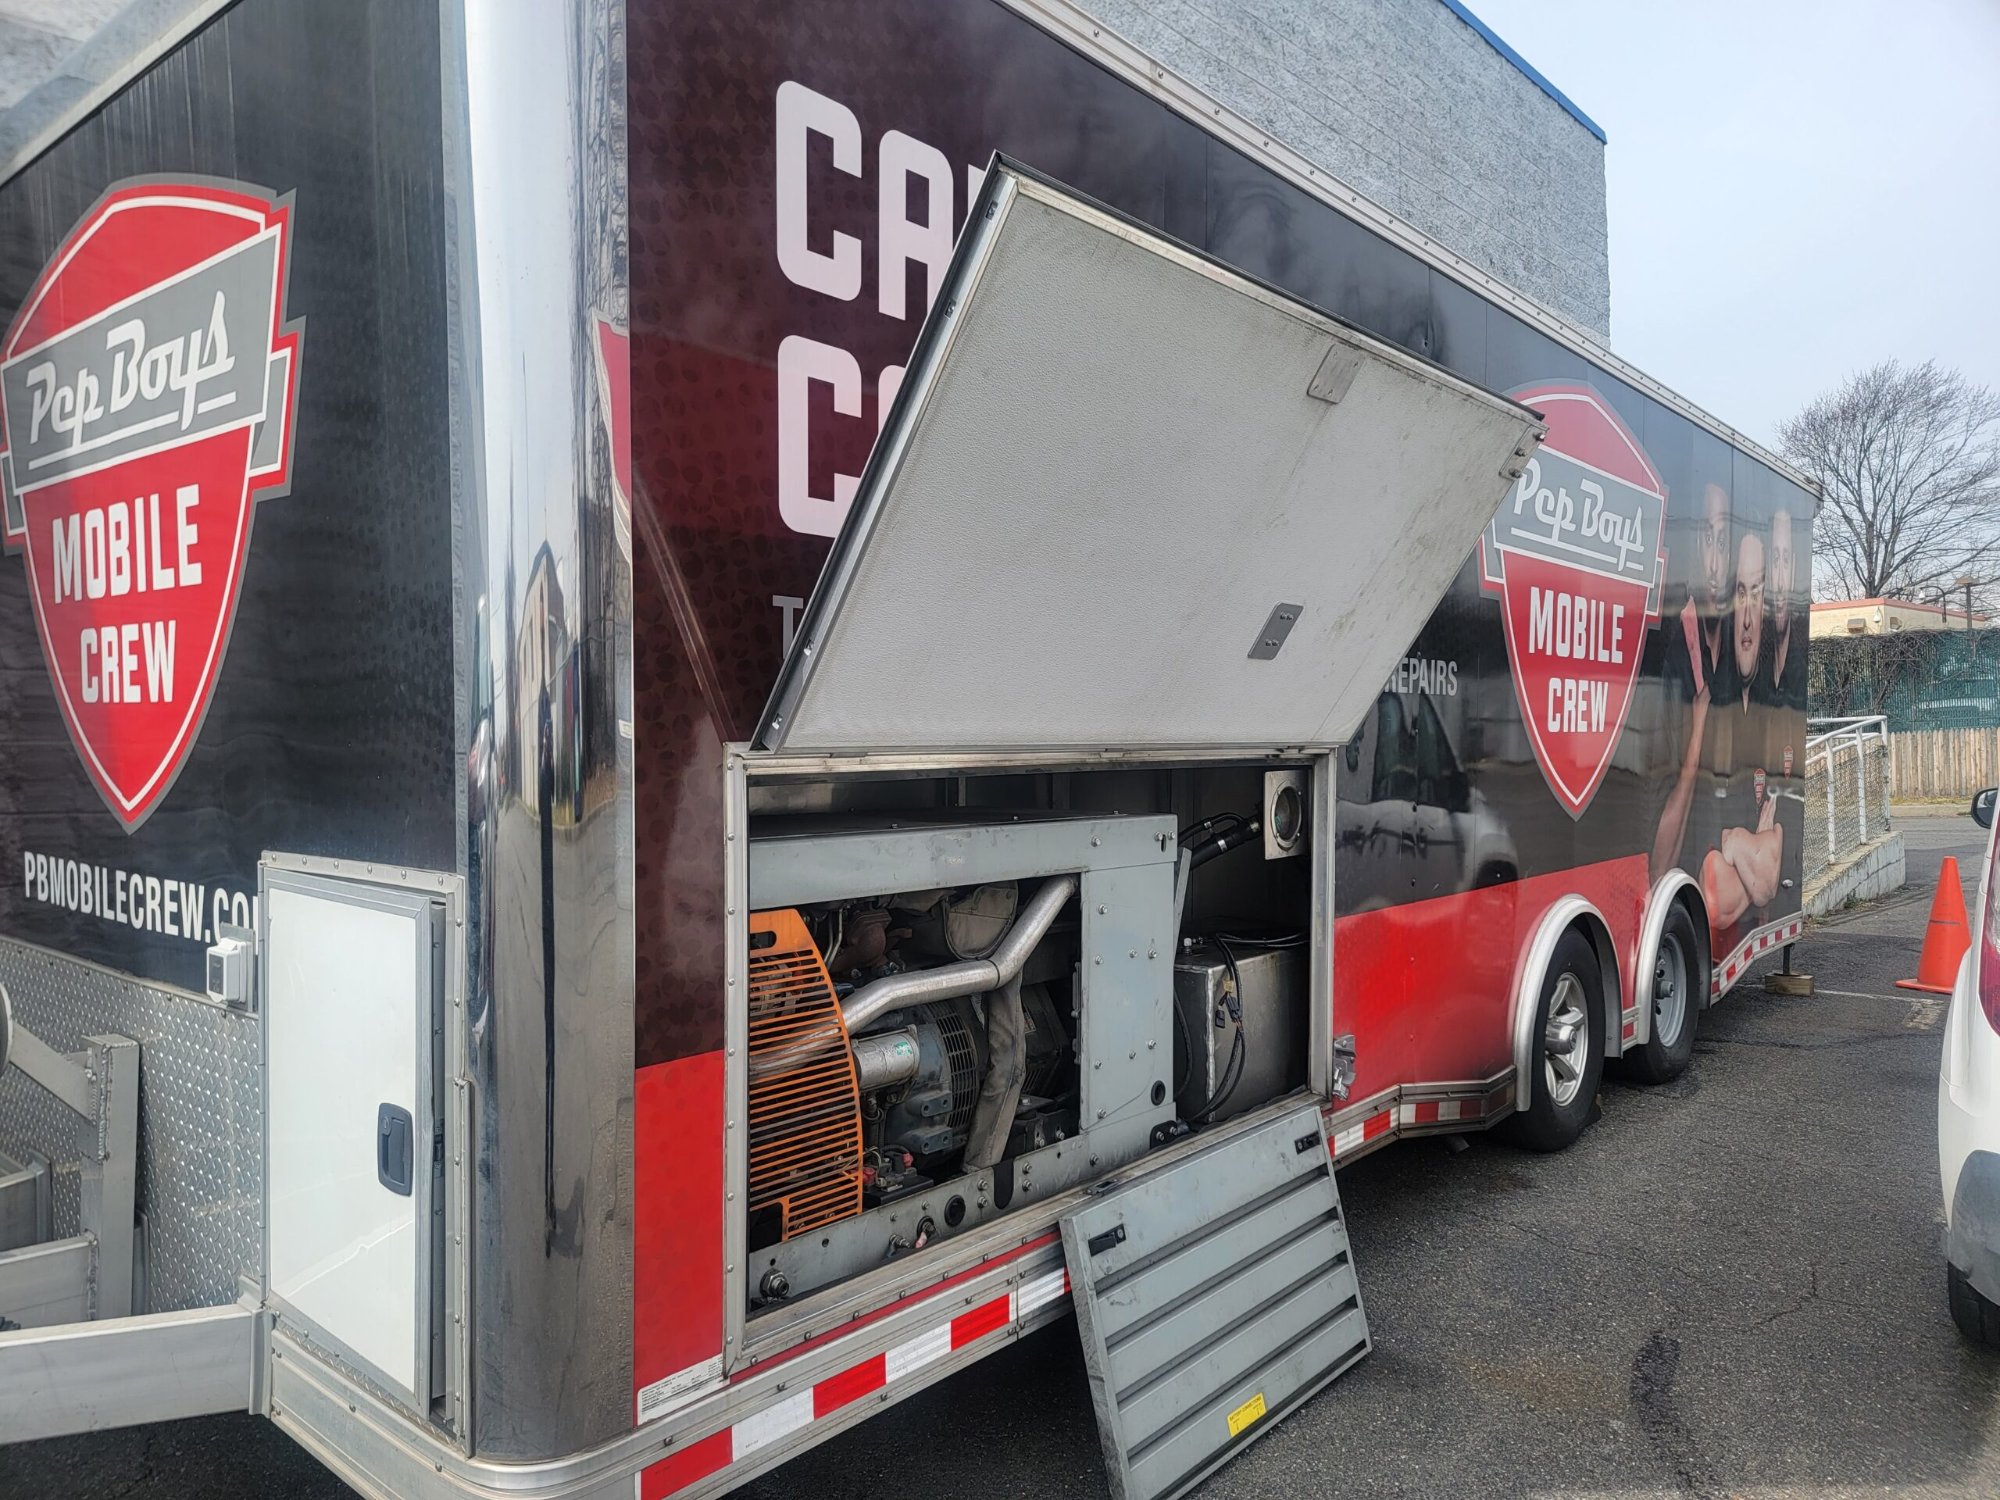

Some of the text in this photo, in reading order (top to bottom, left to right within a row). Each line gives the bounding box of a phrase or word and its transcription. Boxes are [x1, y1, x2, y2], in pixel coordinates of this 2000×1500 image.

[776, 80, 986, 321] CA
[27, 290, 236, 448] Pep Boys
[52, 485, 202, 603] MOBILE
[1513, 457, 1644, 570] Pep Boys
[80, 621, 177, 703] CREW
[1529, 587, 1624, 664] MOBILE
[1548, 678, 1609, 732] CREW
